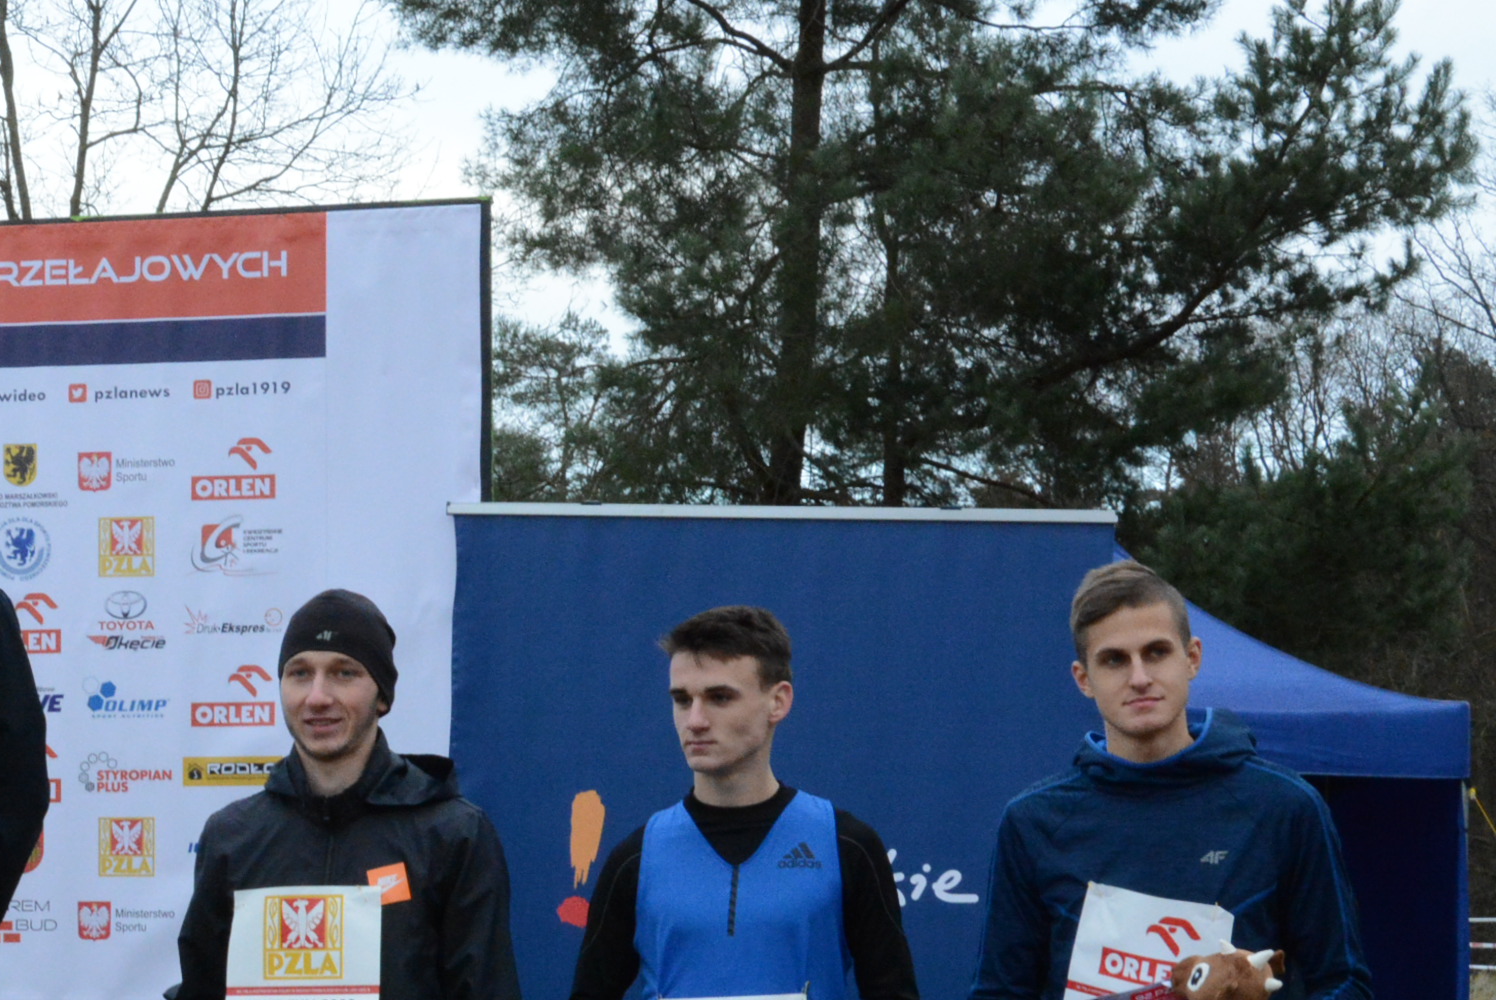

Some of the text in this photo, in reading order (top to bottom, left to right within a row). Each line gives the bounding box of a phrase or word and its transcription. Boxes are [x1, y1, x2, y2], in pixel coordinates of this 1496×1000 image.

[94, 385, 171, 402] pzlanews
[215, 381, 291, 398] pzla1919
[115, 457, 176, 468] Ministerstwo
[115, 472, 148, 483] Sportu
[194, 476, 271, 498] ORLEN
[103, 556, 152, 574] PZLA
[98, 620, 155, 631] TOYOTA
[103, 699, 167, 713] OLIMP
[194, 704, 270, 725] ORLEN
[97, 769, 173, 781] STYROPIAN
[97, 781, 129, 792] PLUS
[104, 857, 152, 874] PZLA
[777, 856, 823, 870] adidas
[115, 908, 176, 919] Ministerstwo
[15, 918, 58, 932] BUD
[115, 922, 148, 933] Sportu
[268, 951, 339, 976] PZLA
[1104, 951, 1173, 983] ORLE
